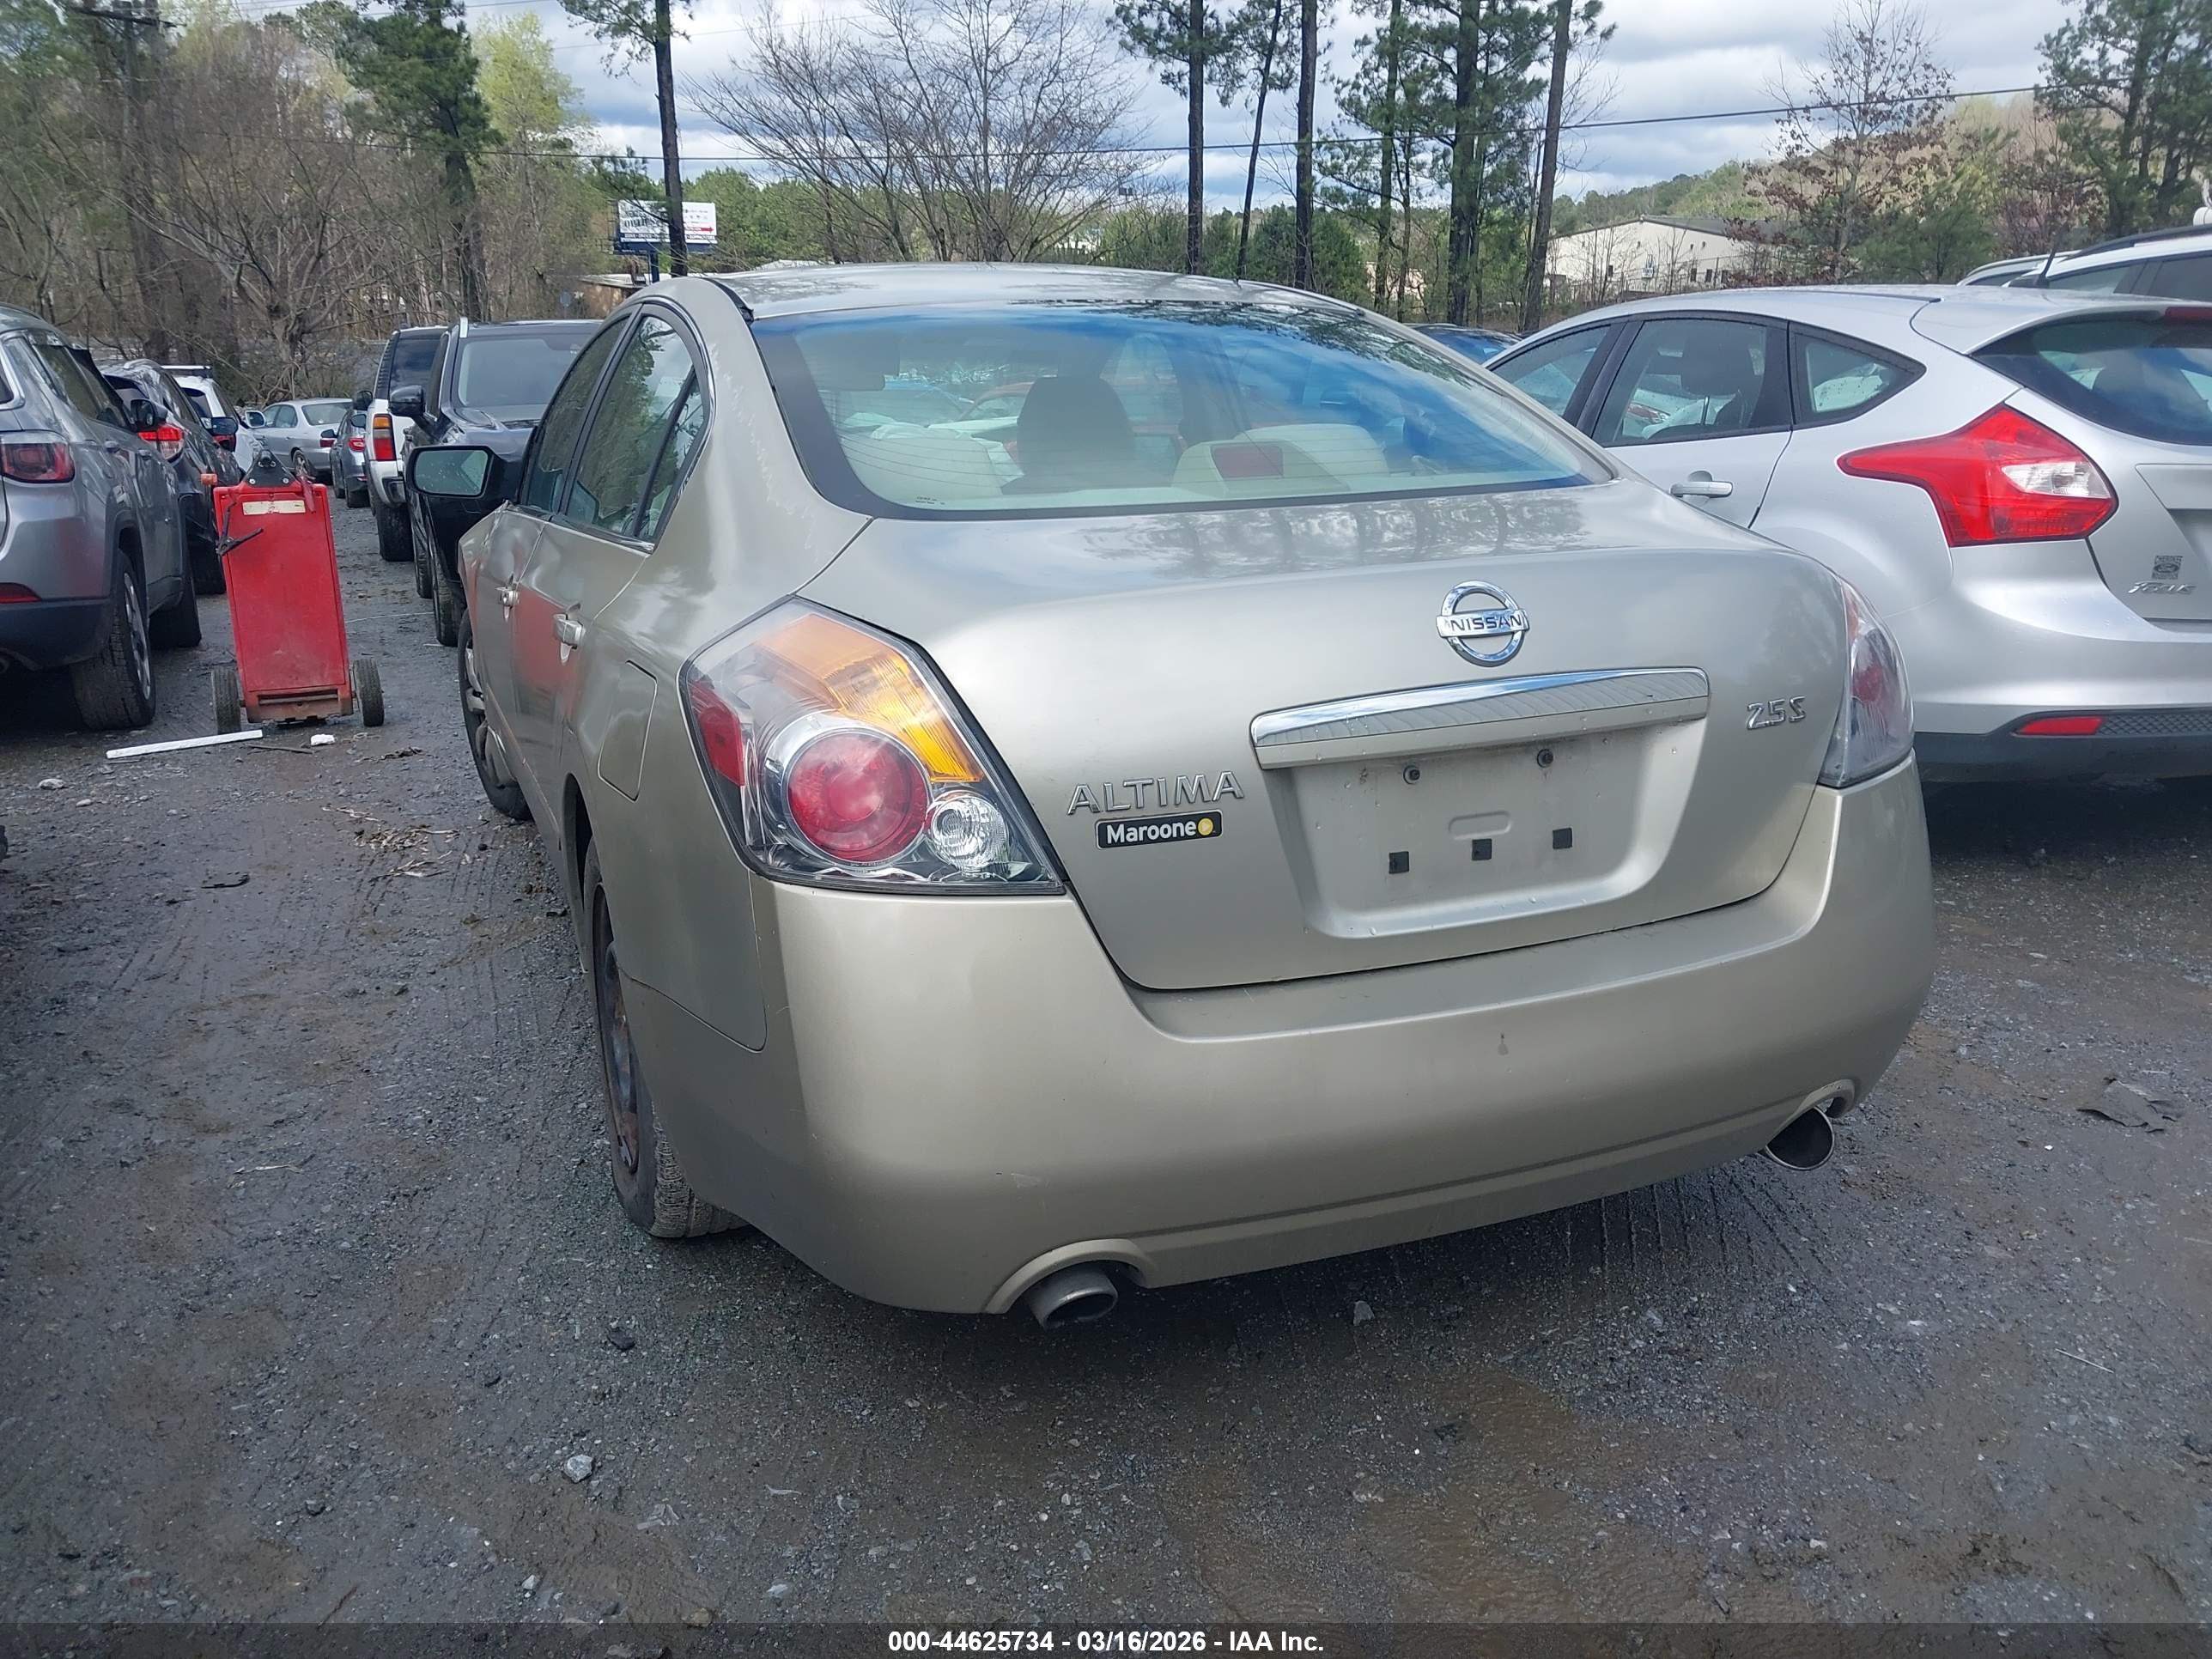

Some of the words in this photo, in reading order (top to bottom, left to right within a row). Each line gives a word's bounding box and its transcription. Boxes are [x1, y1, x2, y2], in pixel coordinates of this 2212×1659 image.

[1450, 615, 1522, 631] NISSAN
[1066, 770, 1244, 816] ALTIMA
[1106, 821, 1197, 845] Maroone
